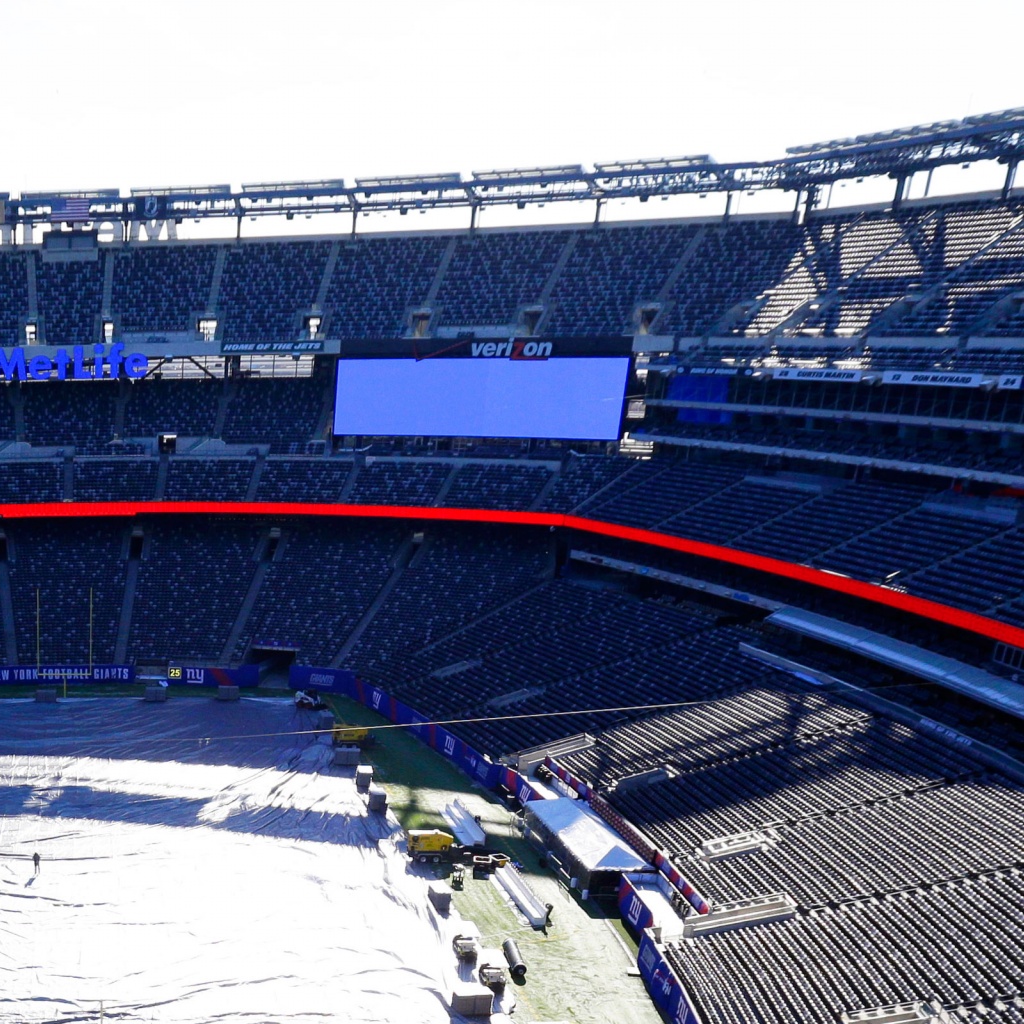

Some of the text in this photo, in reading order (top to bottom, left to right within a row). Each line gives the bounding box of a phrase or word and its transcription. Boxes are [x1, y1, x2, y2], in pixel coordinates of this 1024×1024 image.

[223, 341, 321, 352] HOME OF THE JETS
[471, 337, 553, 359] verizon
[796, 370, 823, 378] CURTIS
[823, 371, 855, 379] MARTIN
[911, 374, 930, 382] DON
[929, 374, 973, 384] MAYNARD
[1002, 378, 1017, 386] 24
[13, 669, 38, 680] YORK
[42, 668, 90, 680] FOOTBALL
[93, 668, 129, 680] GIANTS
[170, 669, 181, 677] 25
[186, 668, 204, 684] ny
[309, 673, 335, 686] GIANTS
